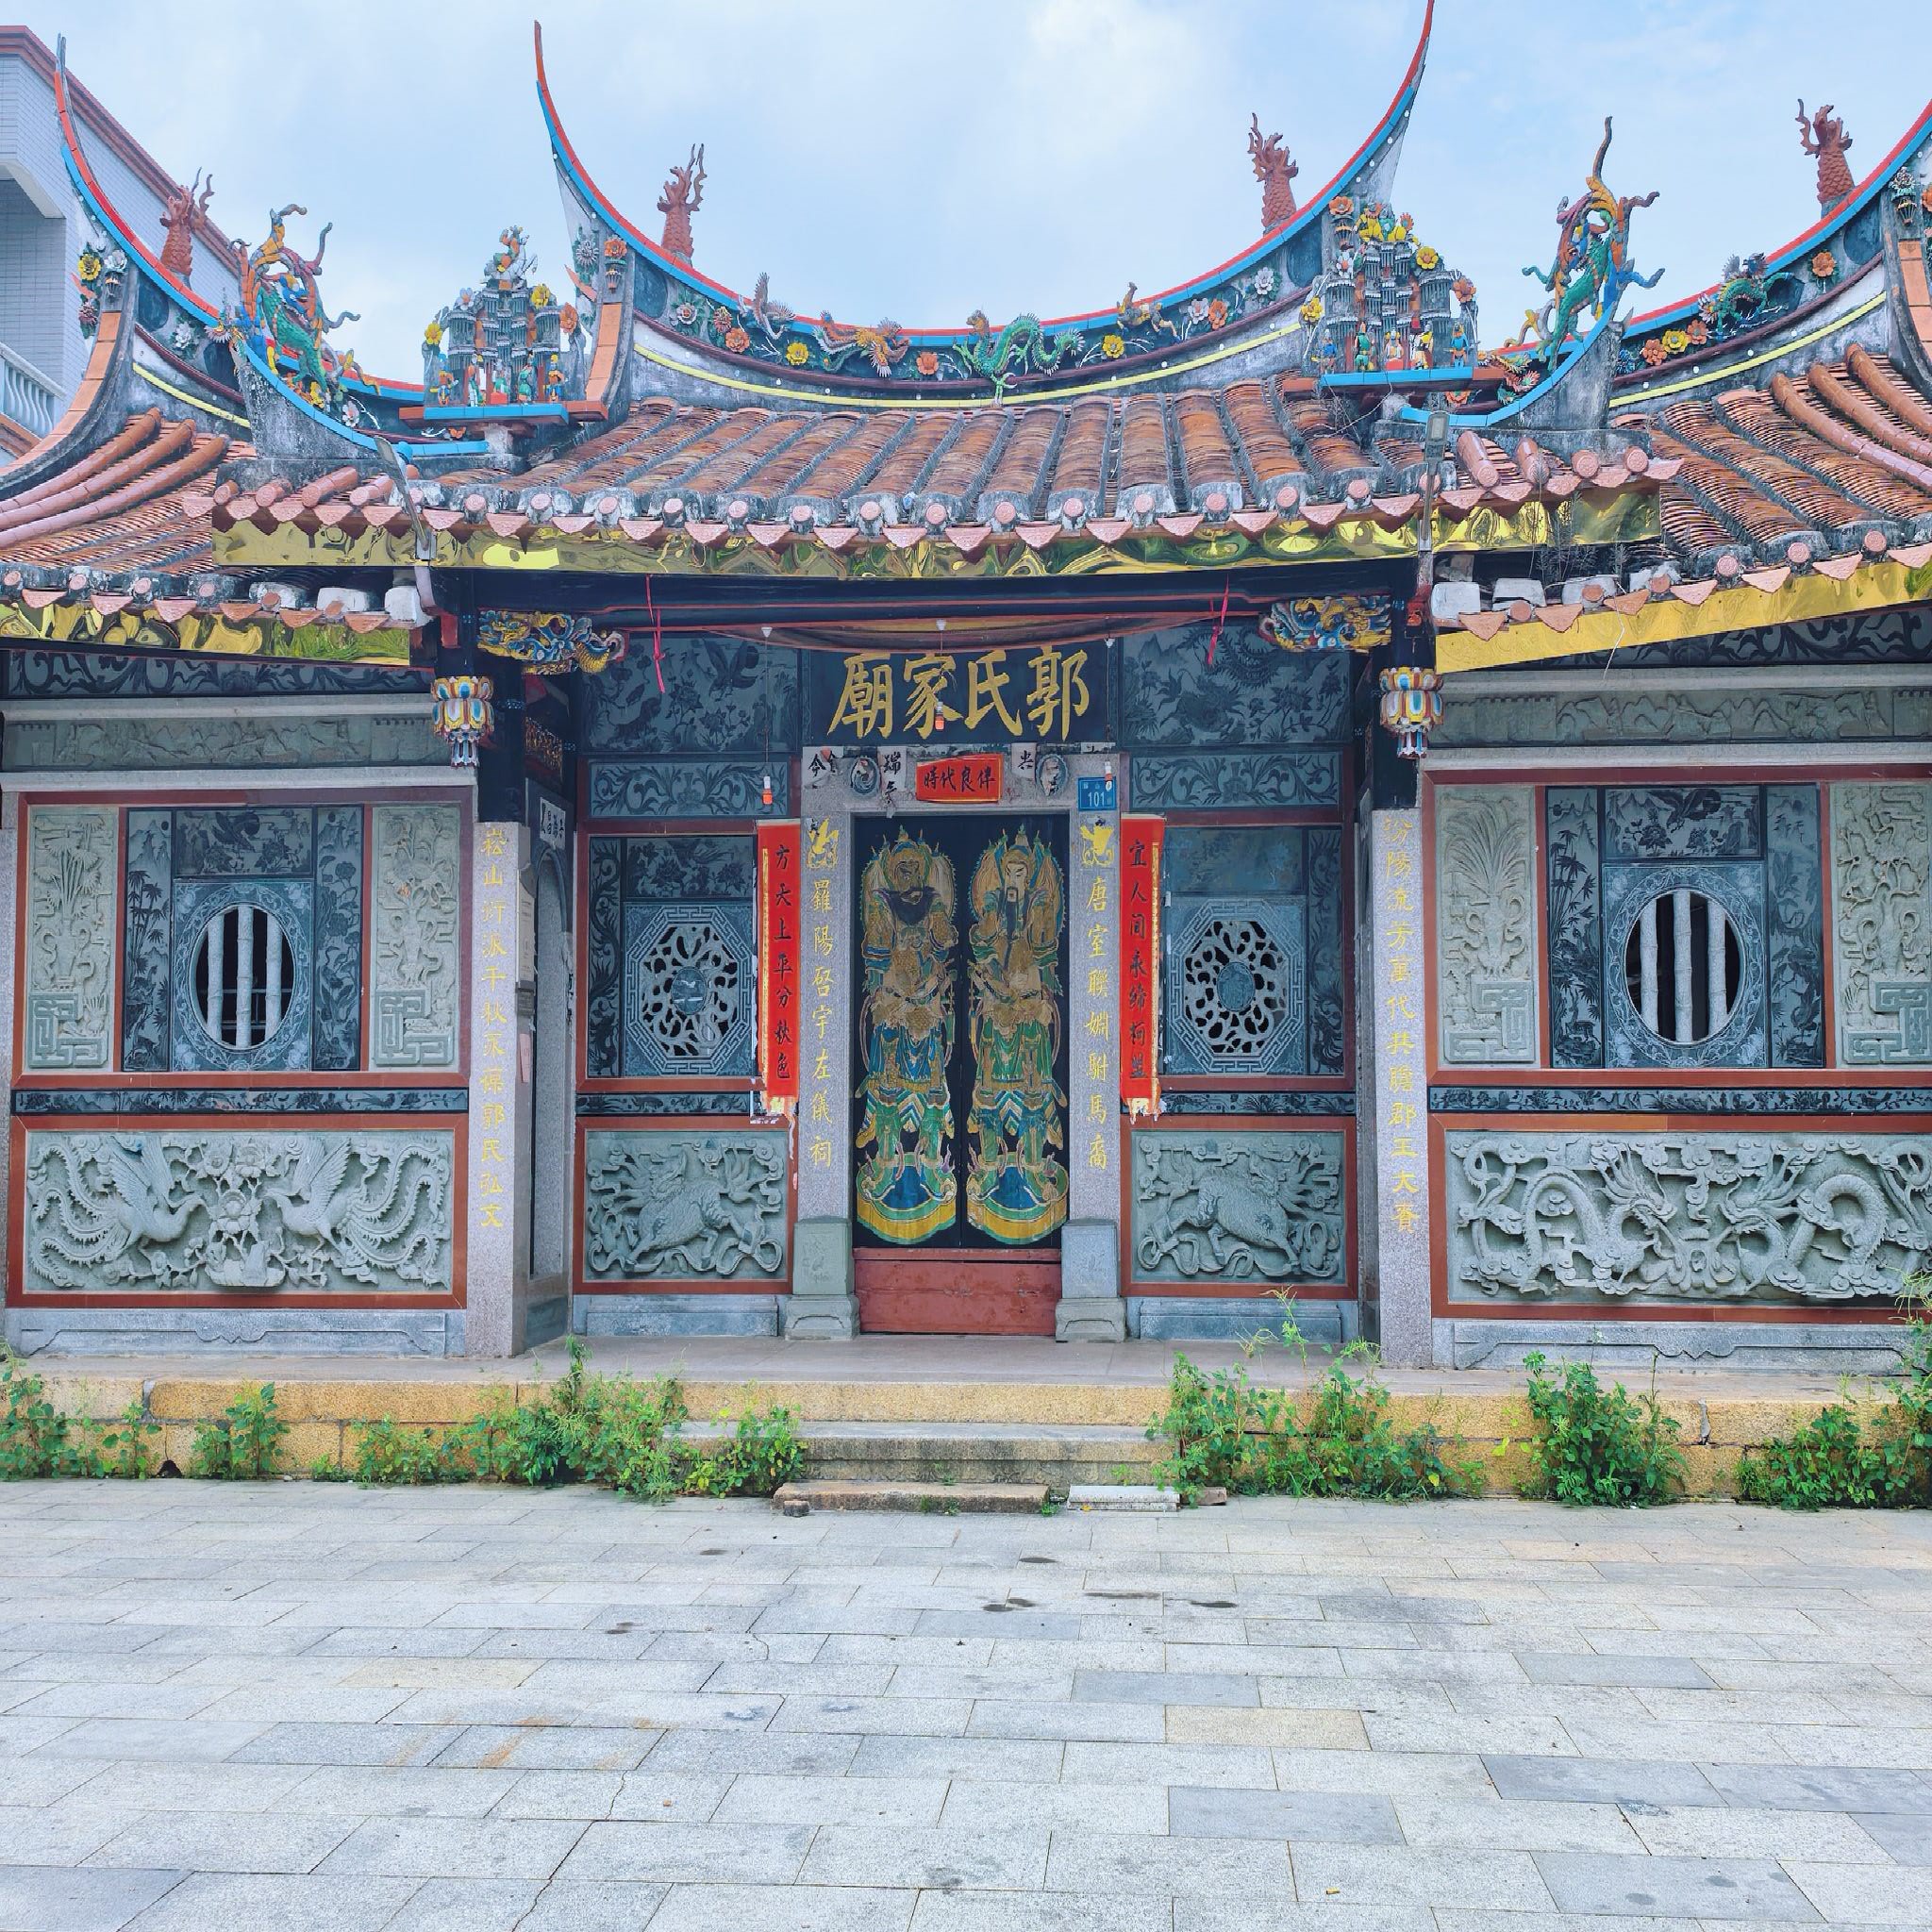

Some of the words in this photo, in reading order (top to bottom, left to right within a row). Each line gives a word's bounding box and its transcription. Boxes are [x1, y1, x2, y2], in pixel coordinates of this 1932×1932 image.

[827, 645, 1090, 741] 郭氏家廟
[1088, 791, 1105, 808] 101
